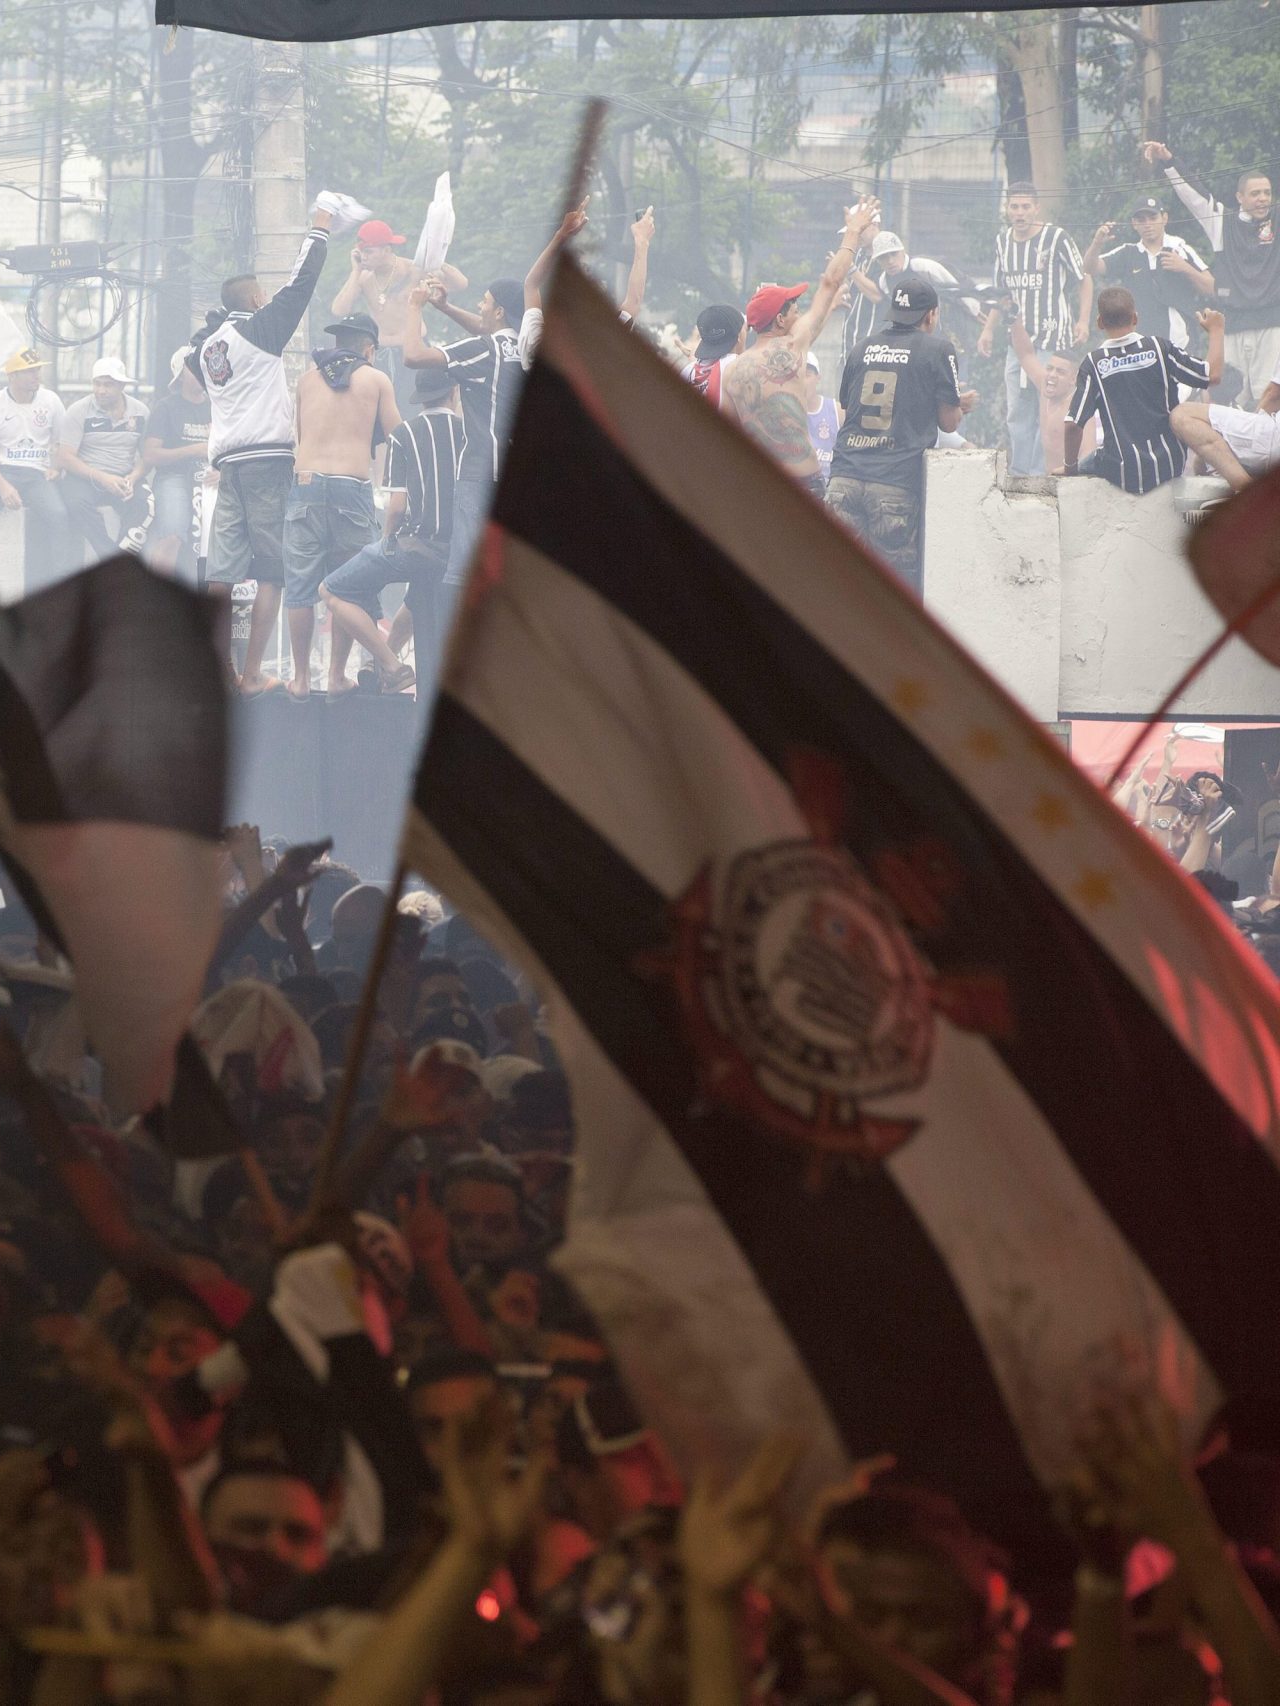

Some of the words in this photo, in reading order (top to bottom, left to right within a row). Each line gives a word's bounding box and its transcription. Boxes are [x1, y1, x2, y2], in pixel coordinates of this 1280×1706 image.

[895, 289, 911, 307] LA
[864, 344, 890, 354] neo
[863, 352, 909, 366] química
[1111, 350, 1155, 368] batavo
[859, 370, 898, 431] 9
[6, 447, 48, 459] batavo
